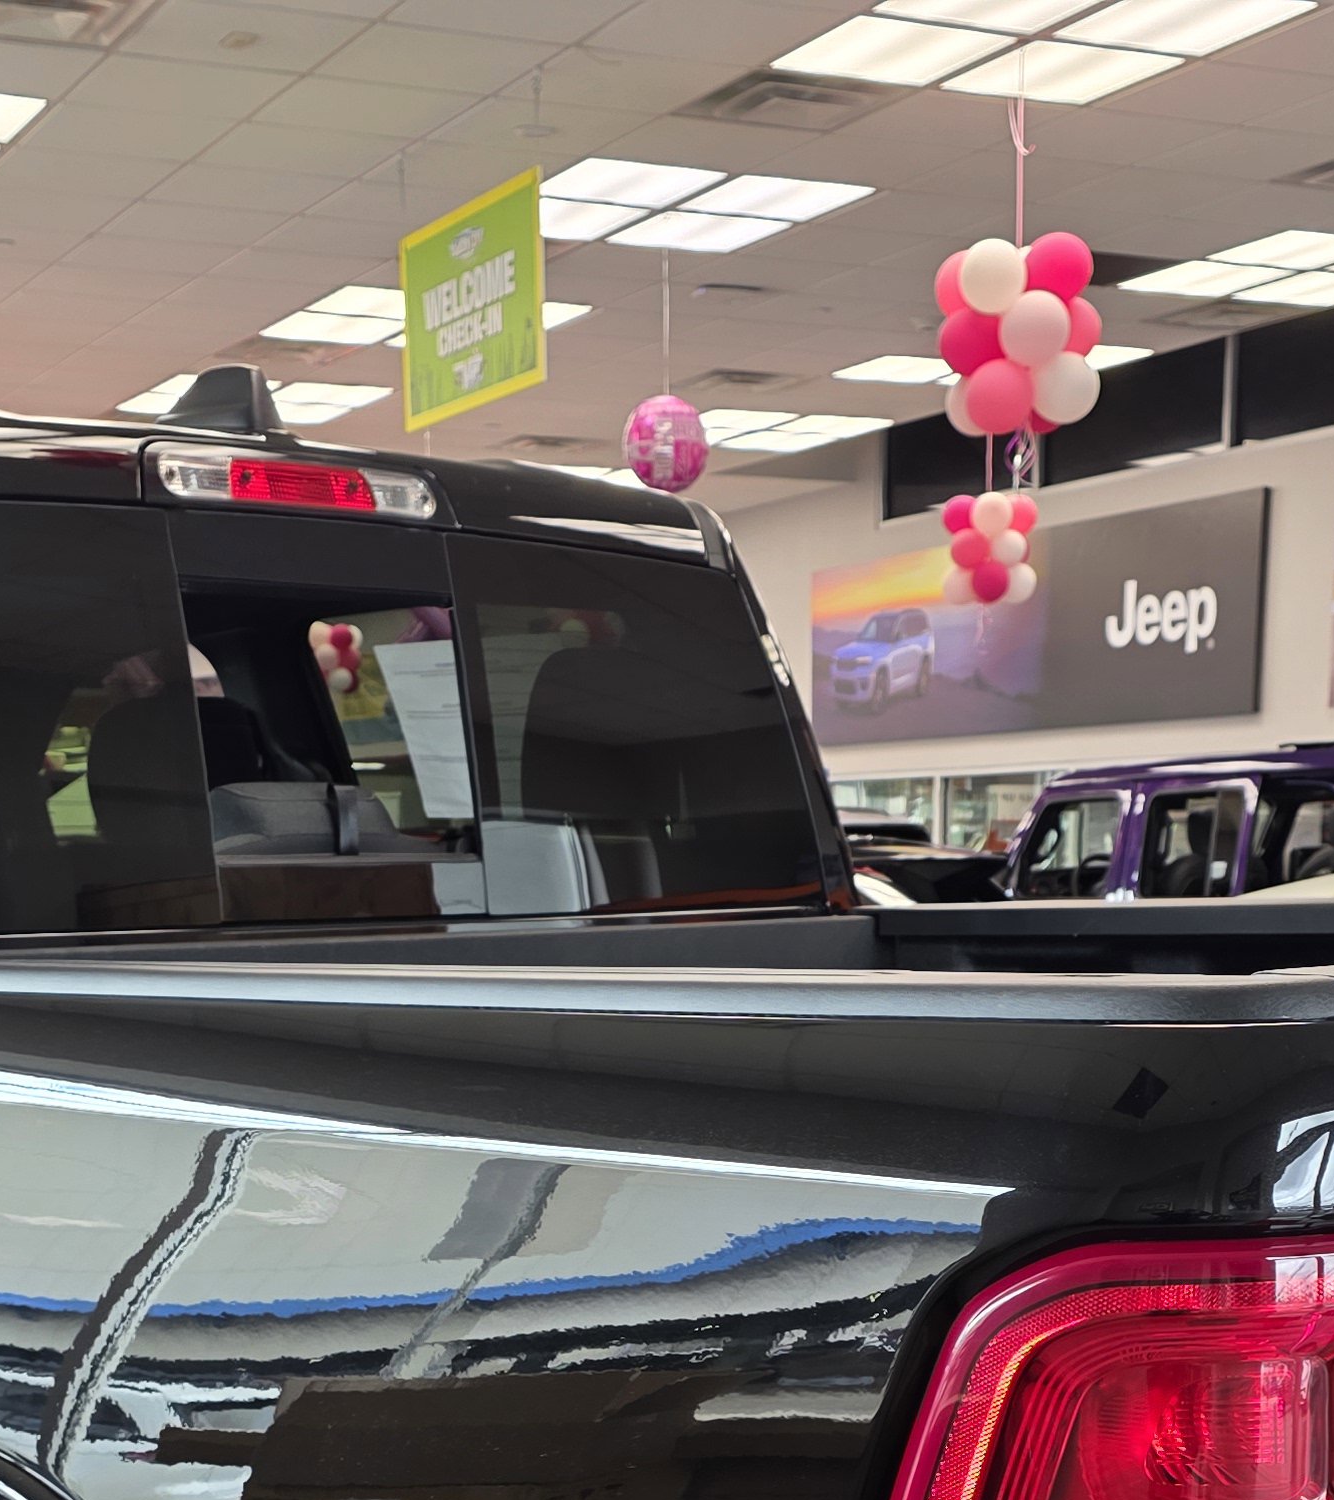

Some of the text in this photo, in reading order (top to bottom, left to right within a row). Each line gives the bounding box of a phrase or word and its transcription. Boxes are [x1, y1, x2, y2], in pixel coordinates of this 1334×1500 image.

[422, 249, 516, 332] WELCOME
[436, 302, 504, 357] CHECK-IN
[1105, 579, 1217, 654] Jeep
